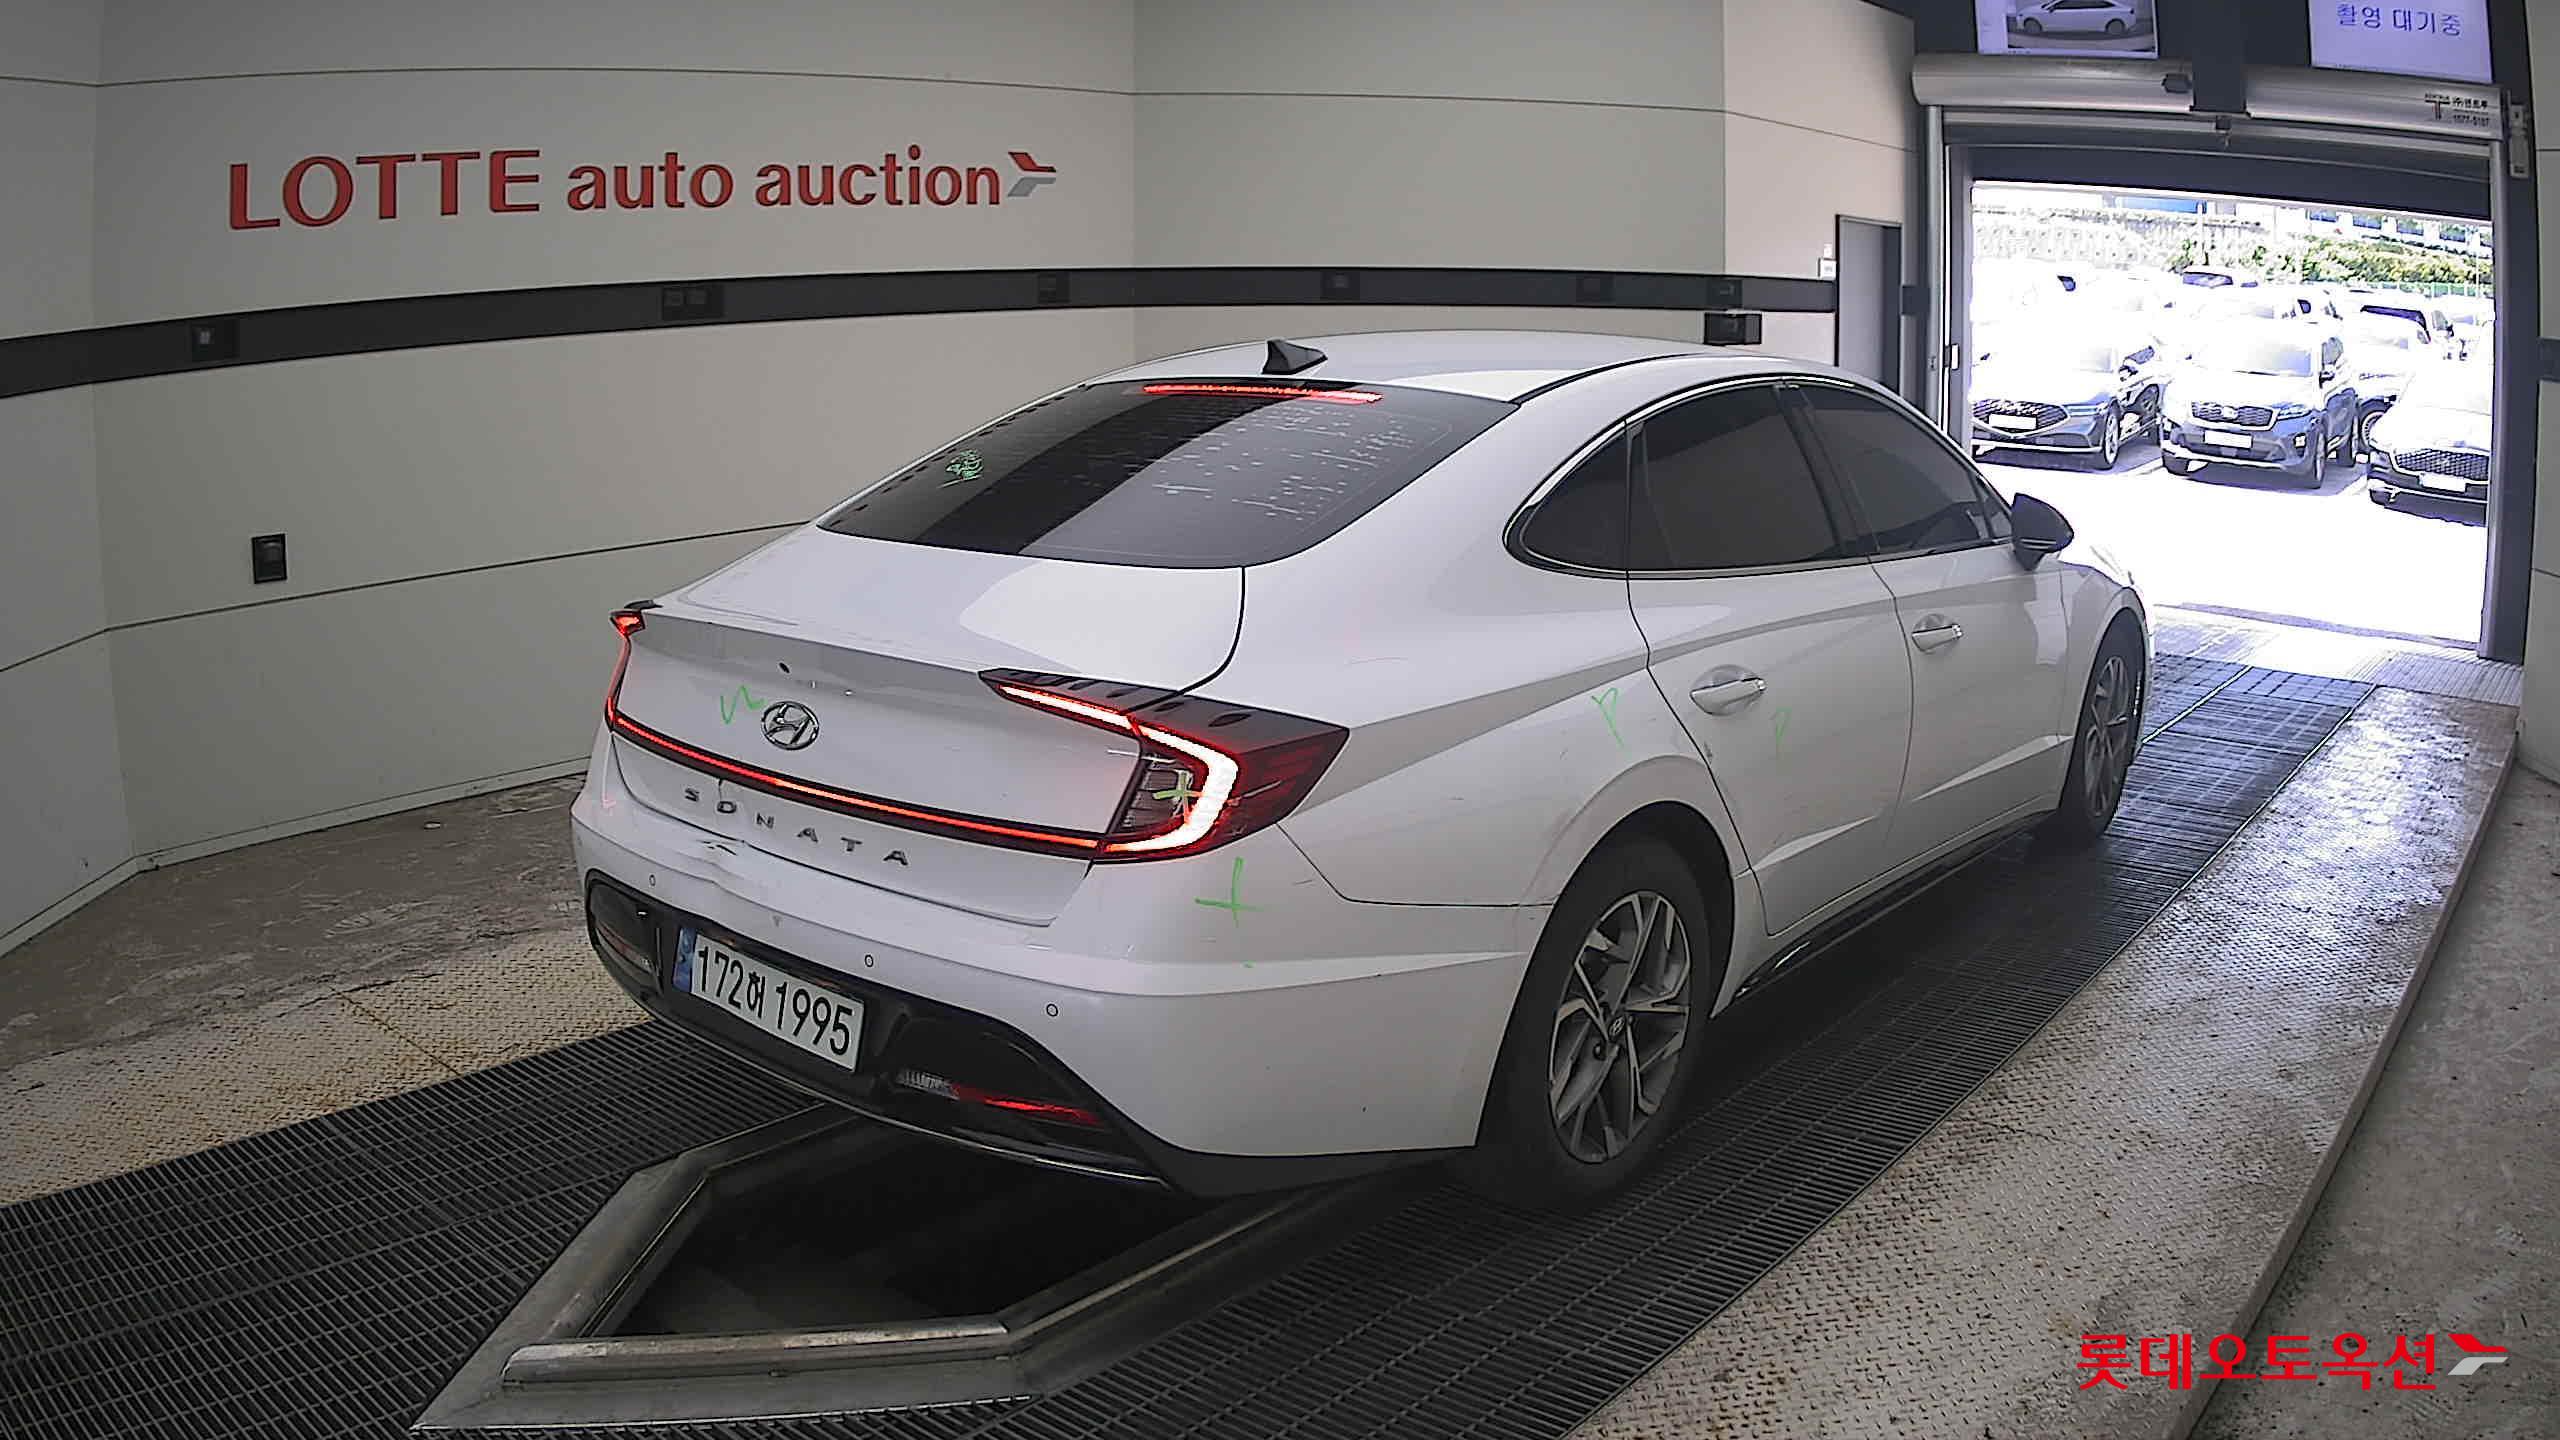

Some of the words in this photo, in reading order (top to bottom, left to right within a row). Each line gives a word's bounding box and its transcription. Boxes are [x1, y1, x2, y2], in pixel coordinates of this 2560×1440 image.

[2337, 3, 2382, 29] 촬영
[2392, 8, 2461, 37] 대기중
[229, 149, 541, 231] LOTTE
[566, 151, 734, 210] auto
[754, 144, 1002, 207] auction
[684, 786, 909, 867] SONATA
[698, 945, 766, 1020] 172허
[775, 980, 853, 1056] 1995
